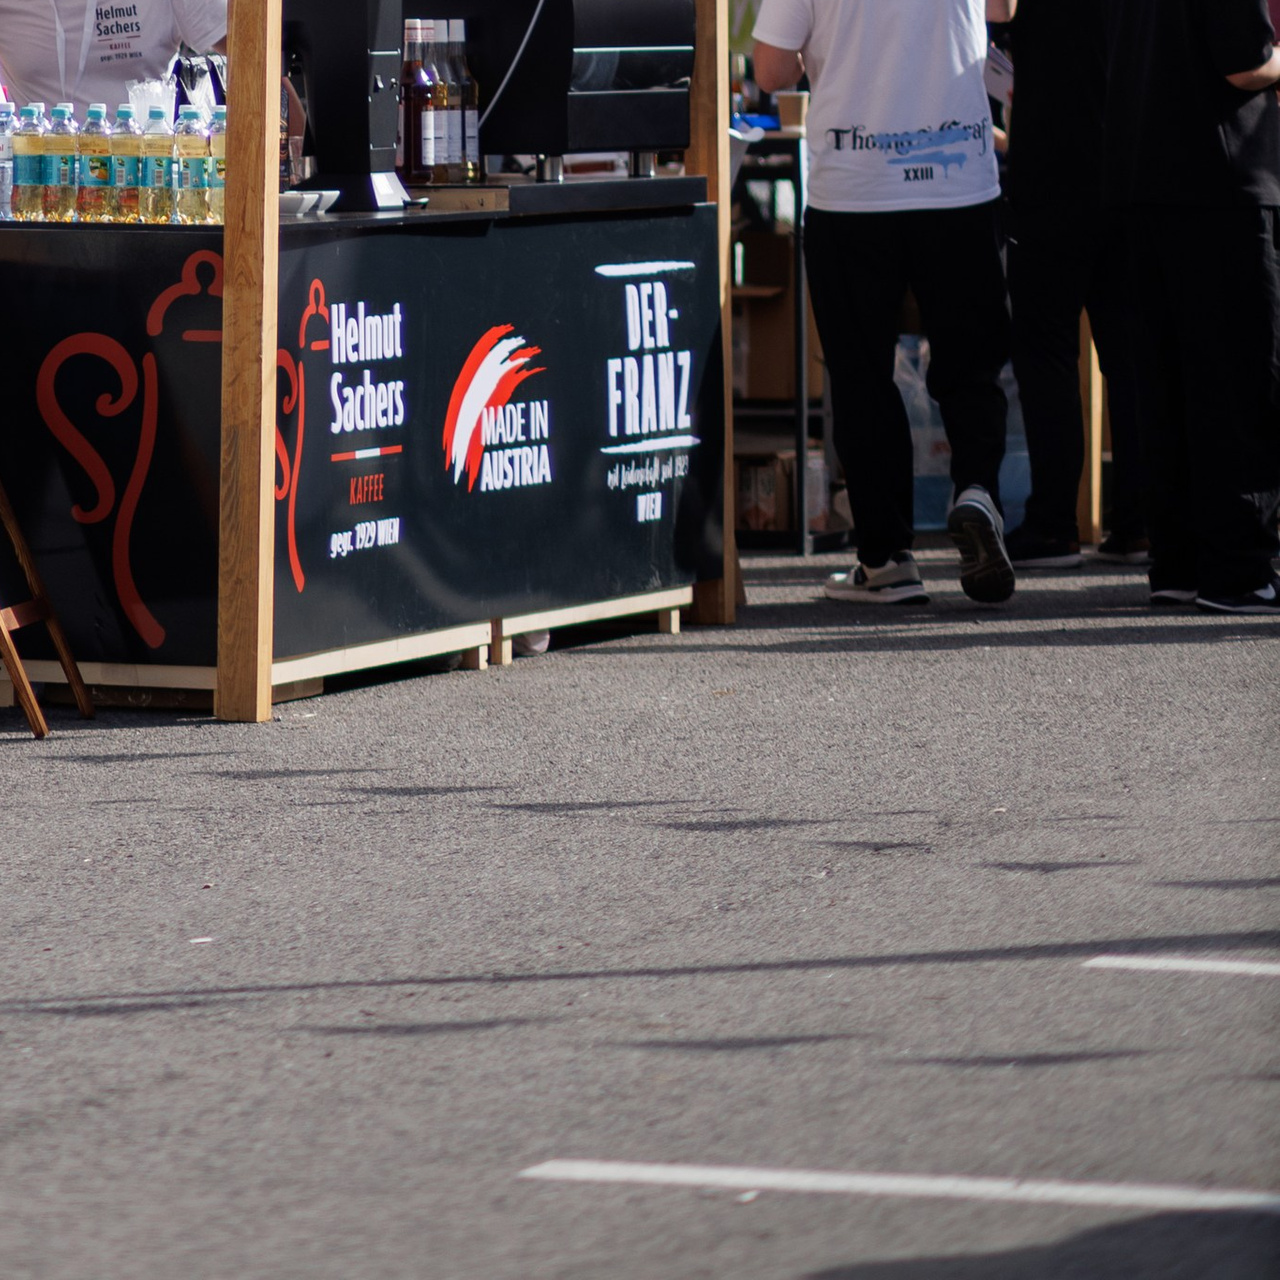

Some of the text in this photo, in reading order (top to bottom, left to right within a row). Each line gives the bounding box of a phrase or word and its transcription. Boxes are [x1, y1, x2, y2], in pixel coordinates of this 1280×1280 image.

[95, 4, 138, 20] Helmut
[96, 20, 141, 37] Sachers
[903, 166, 934, 182] XXIII
[331, 301, 403, 364] Helmut
[625, 282, 678, 351] DER-
[330, 370, 405, 434] Sachers
[607, 351, 692, 437] FRANZ
[480, 400, 549, 446] MADE IN
[349, 472, 385, 506] KAFFEE
[480, 444, 552, 492] AUSTRIA
[355, 521, 377, 550] 1929
[377, 517, 400, 547] WIEN
